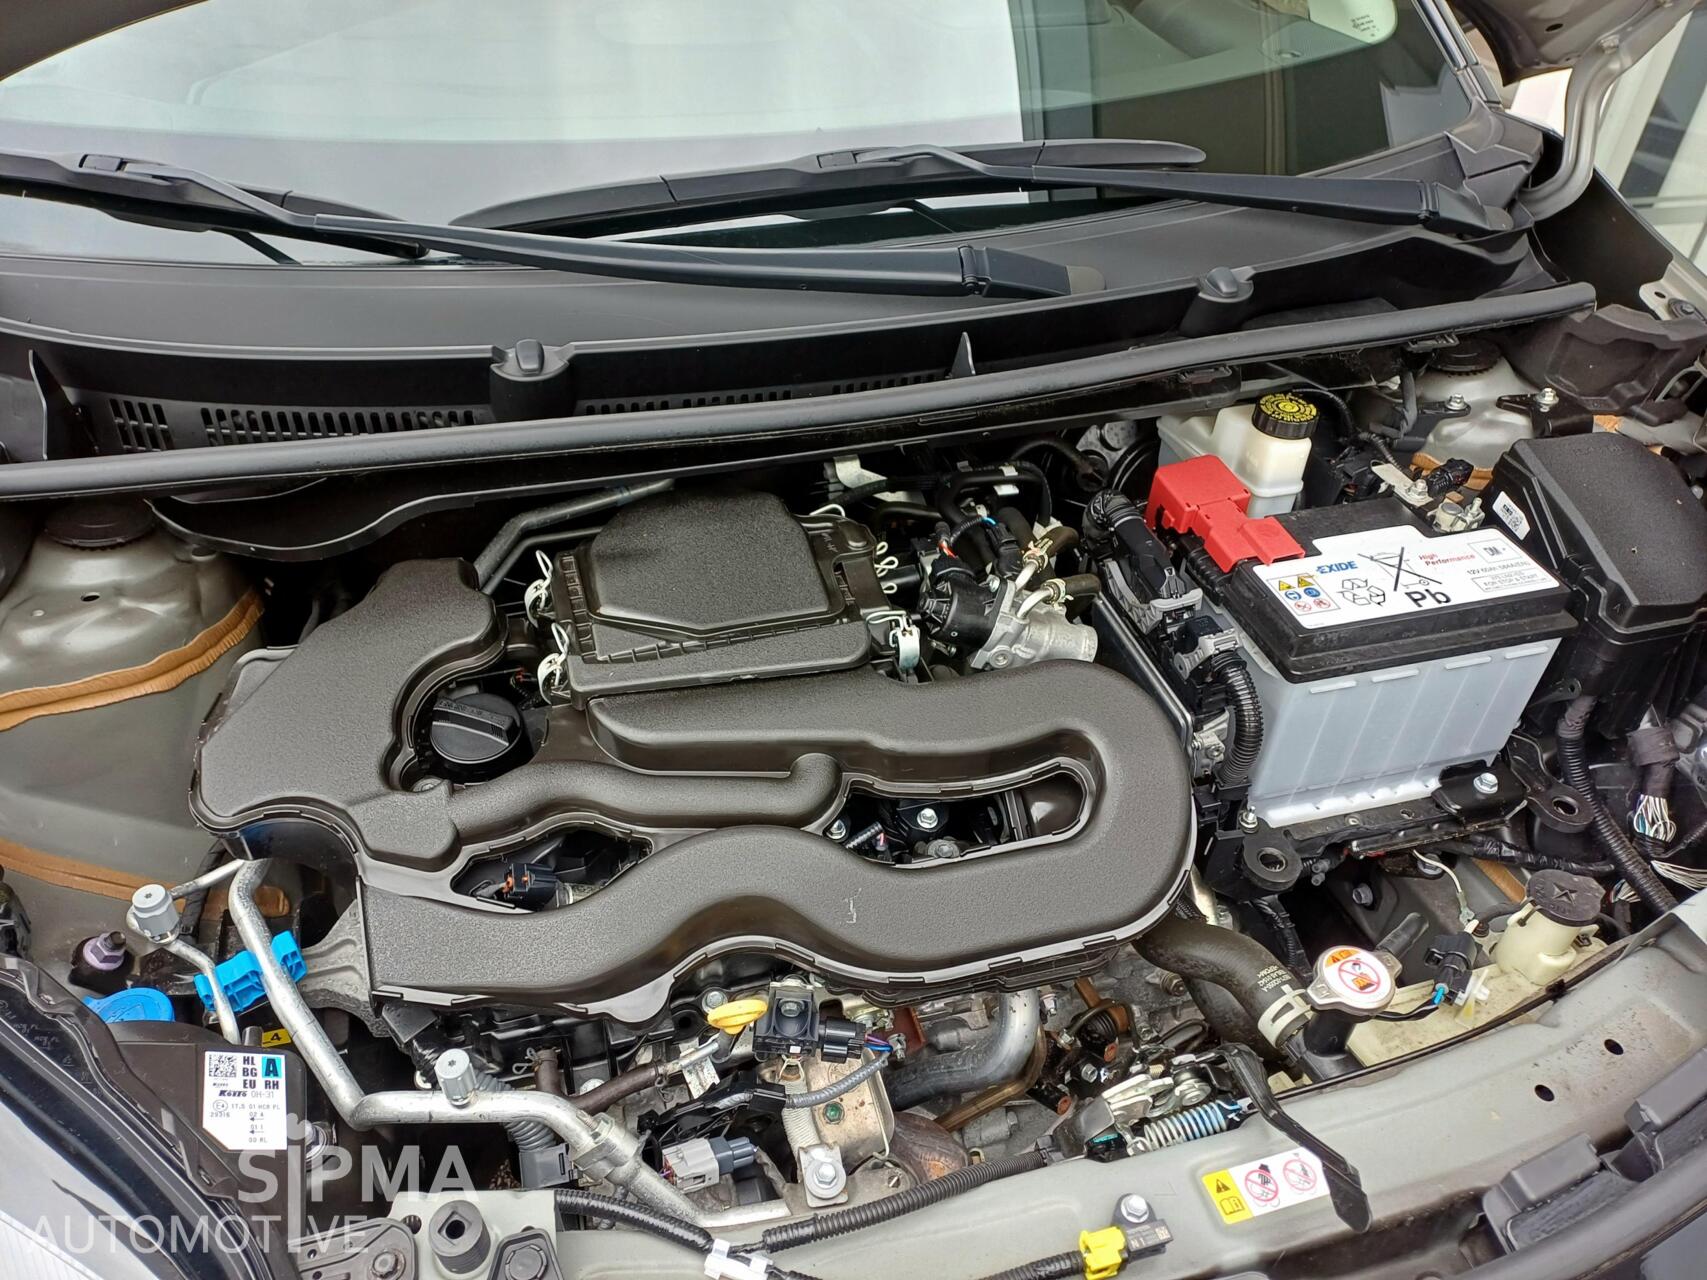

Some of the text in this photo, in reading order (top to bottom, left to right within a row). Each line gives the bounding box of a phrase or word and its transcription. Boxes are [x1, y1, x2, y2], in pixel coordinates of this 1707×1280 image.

[1418, 552, 1439, 562] High
[1424, 553, 1476, 567] Performance
[1316, 560, 1359, 574] EXIDE
[1404, 588, 1452, 608] Pb
[242, 1055, 256, 1066] HL
[242, 1067, 258, 1078] BG
[264, 1058, 279, 1077] A
[242, 1079, 257, 1089] EU
[264, 1080, 280, 1090] RH
